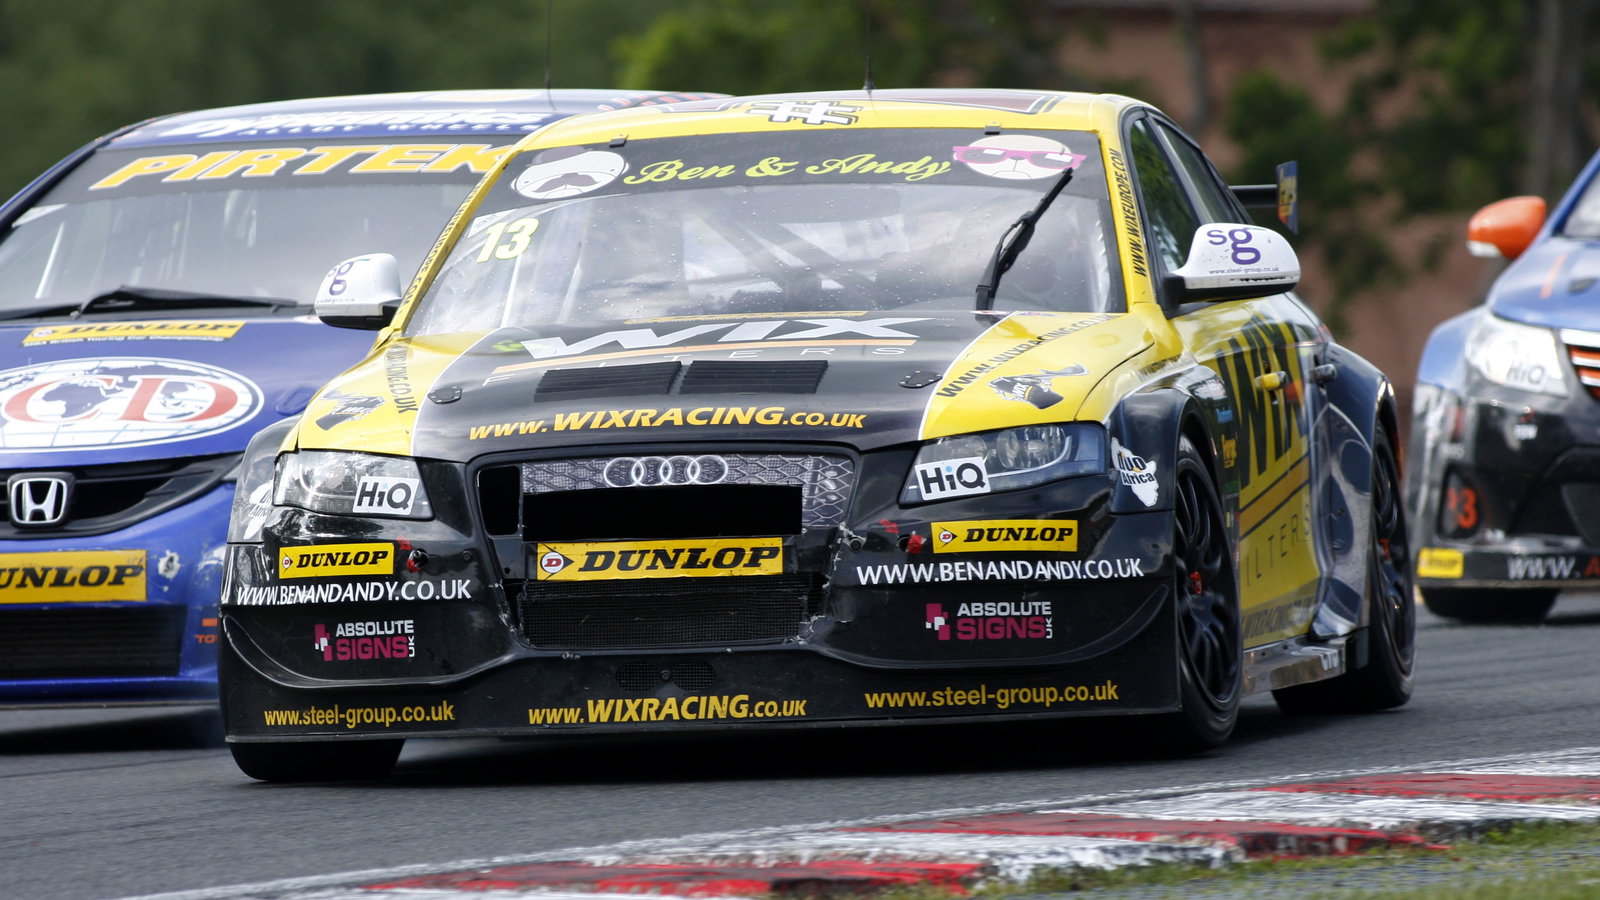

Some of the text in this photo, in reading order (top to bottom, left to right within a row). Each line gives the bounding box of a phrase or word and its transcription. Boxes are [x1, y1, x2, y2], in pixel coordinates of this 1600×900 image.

[88, 143, 514, 190] PIRTEK
[623, 154, 952, 184] Ben & Andy
[1109, 148, 1147, 277] WWW.WIXEUROPE.COM
[476, 217, 540, 264] 13
[1206, 227, 1261, 265] sg
[520, 317, 937, 359] WIX
[919, 462, 986, 494] HiQ
[1122, 472, 1156, 485] Africa
[356, 481, 412, 510] HiQ
[963, 527, 1074, 543] DUNLOP
[296, 550, 389, 569] DUNLOP
[578, 546, 781, 573] DUNLOP
[856, 558, 1145, 586] WWW.BENANDANDY.CO.UK
[0, 565, 145, 589] UNLOP
[236, 578, 472, 606] WWW.BENANDANDY.CO.UK
[956, 601, 1052, 617] ABSOLUTE
[336, 619, 414, 637] ABSOLUTE
[956, 616, 1046, 640] SIGNS
[336, 636, 409, 661] SIGNS
[864, 680, 1119, 709] www.steel-group.co.uk
[264, 700, 456, 729] www.steel-group.co.uk
